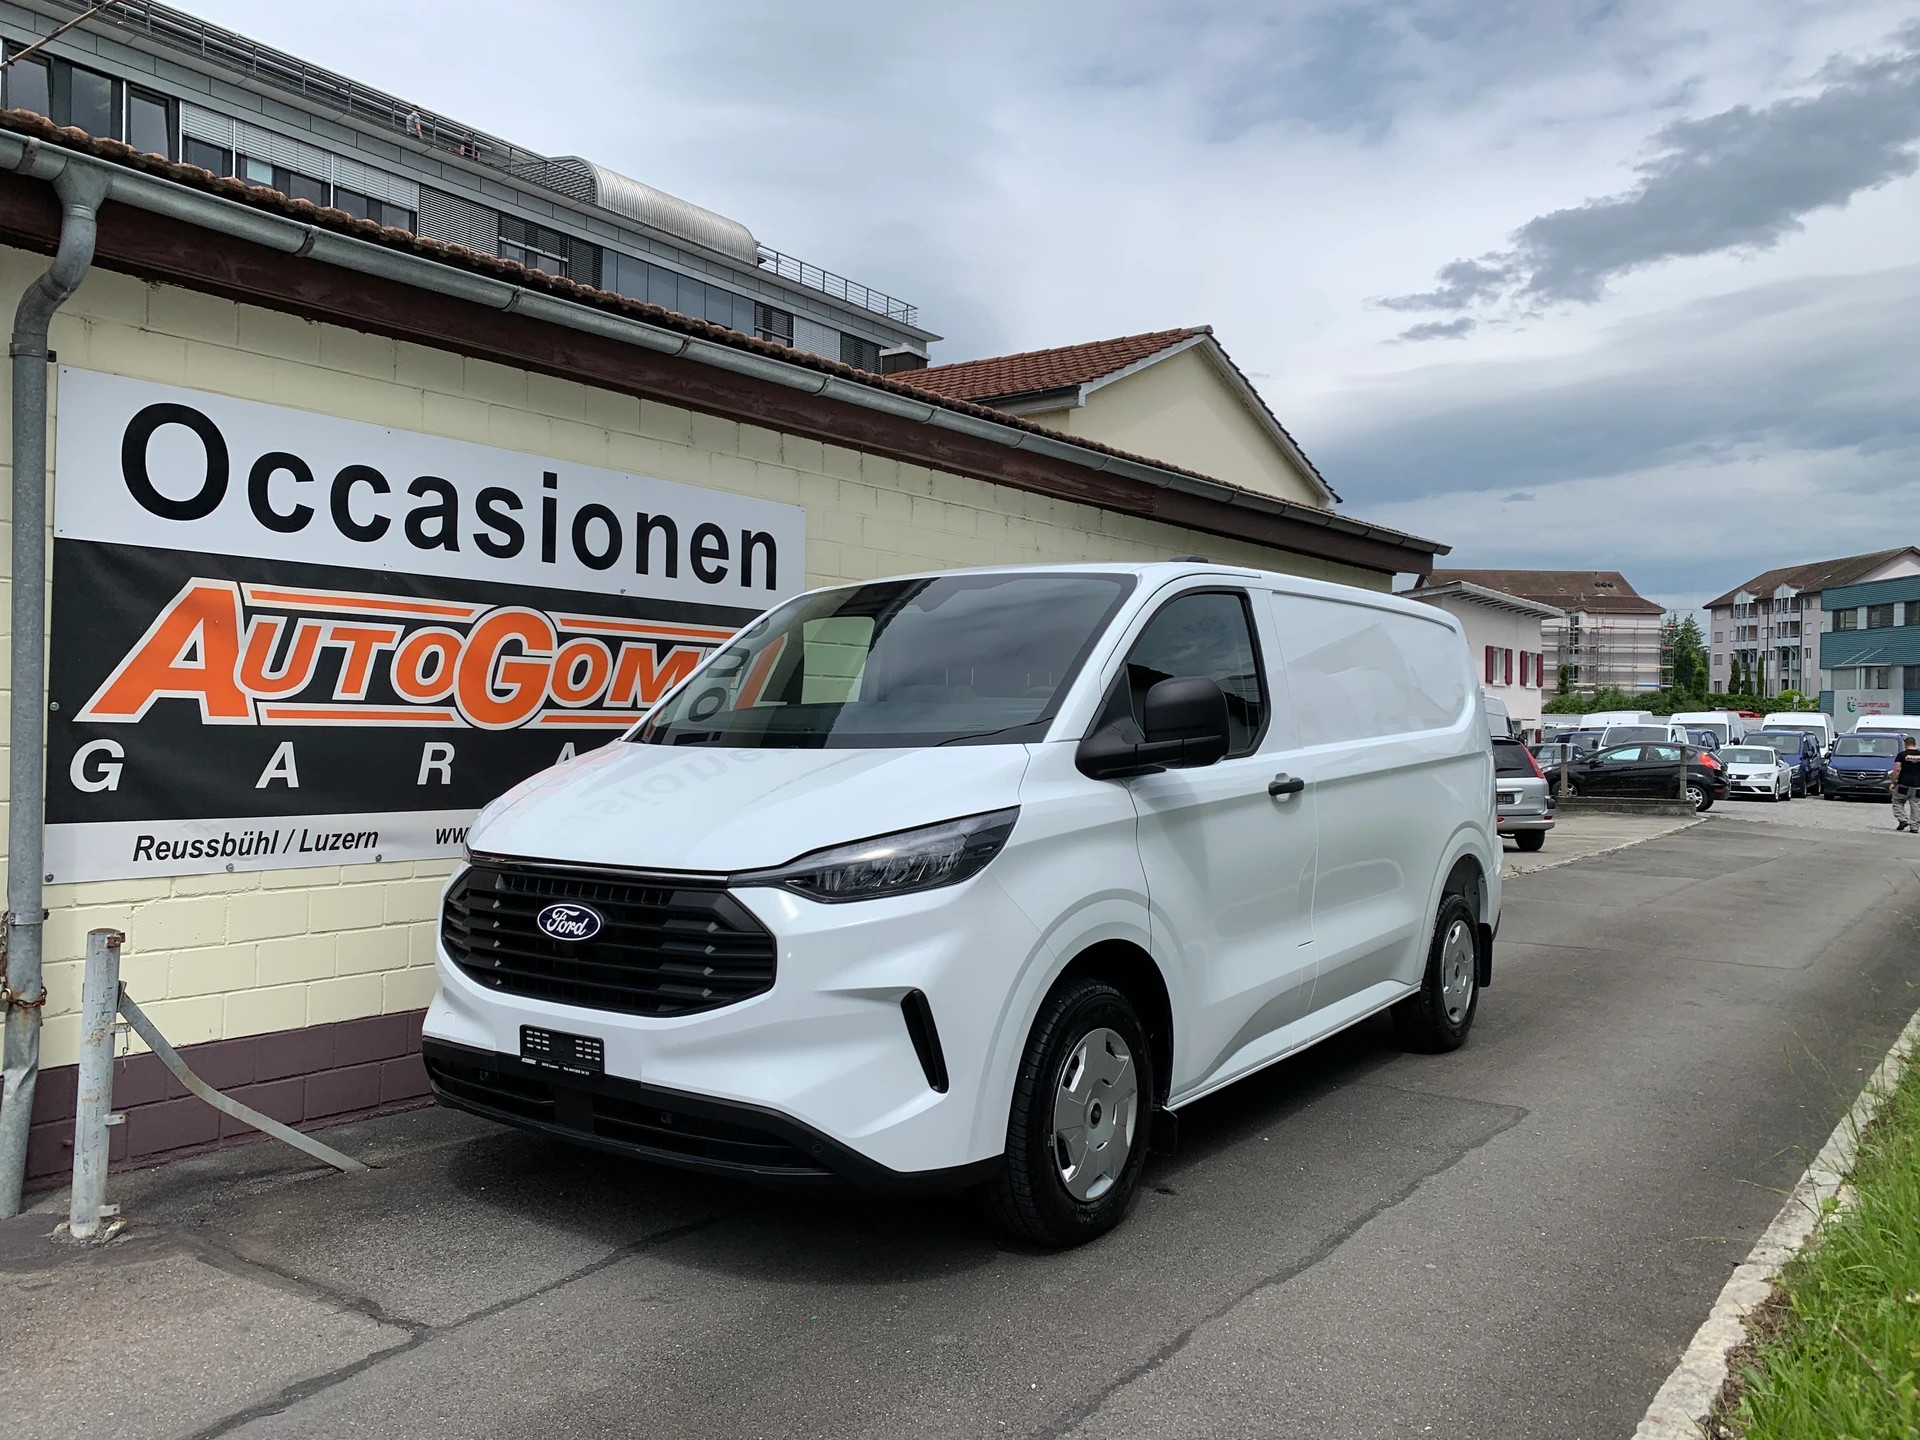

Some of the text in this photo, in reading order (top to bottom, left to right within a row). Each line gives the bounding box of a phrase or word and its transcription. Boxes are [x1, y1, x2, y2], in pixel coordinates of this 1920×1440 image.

[121, 402, 778, 591] Occasionen
[73, 577, 712, 730] AUTOGOM
[132, 829, 280, 863] Reussbühl
[298, 828, 379, 853] Luzern
[546, 907, 590, 936] Ford
